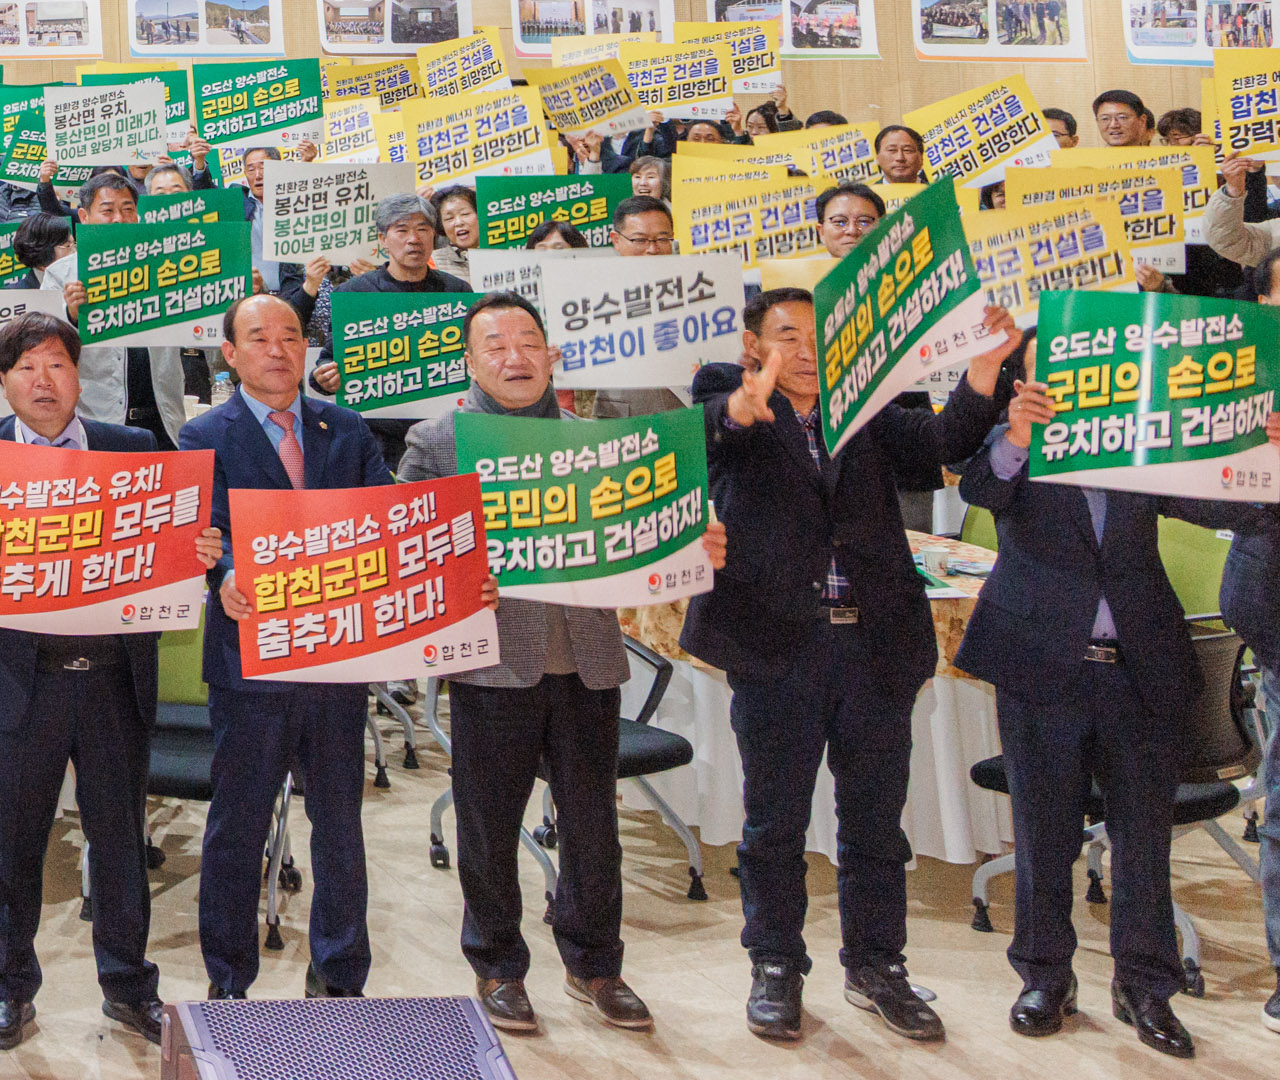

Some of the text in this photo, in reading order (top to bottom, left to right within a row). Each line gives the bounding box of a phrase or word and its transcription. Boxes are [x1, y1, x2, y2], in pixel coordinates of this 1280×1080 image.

[55, 90, 125, 113] 친환경 양수발전소
[55, 100, 131, 129] 봉산면 유치,
[55, 109, 157, 146] 봉산면의 미래가
[55, 127, 161, 160] 100년 앞당겨 집니다.
[562, 271, 716, 330] 양수발전소
[561, 306, 737, 371] 합천이 좋아요
[1048, 313, 1244, 363] 오도산 양수발전소
[1047, 345, 1256, 412] 군민의 손으로
[475, 428, 659, 482] 오도산 양수발전소
[1041, 410, 1172, 461] 유치하고
[109, 464, 163, 499] 유치!
[482, 452, 678, 530] 군민의 손으로
[111, 486, 200, 541] 모두를
[252, 492, 436, 564] 양수발전소 유치!
[487, 487, 702, 575] 유치하고 건설하자!
[81, 542, 156, 593] 한다!
[254, 511, 475, 612] 합천군민 모두를
[257, 576, 445, 660] 춤추게 한다!
